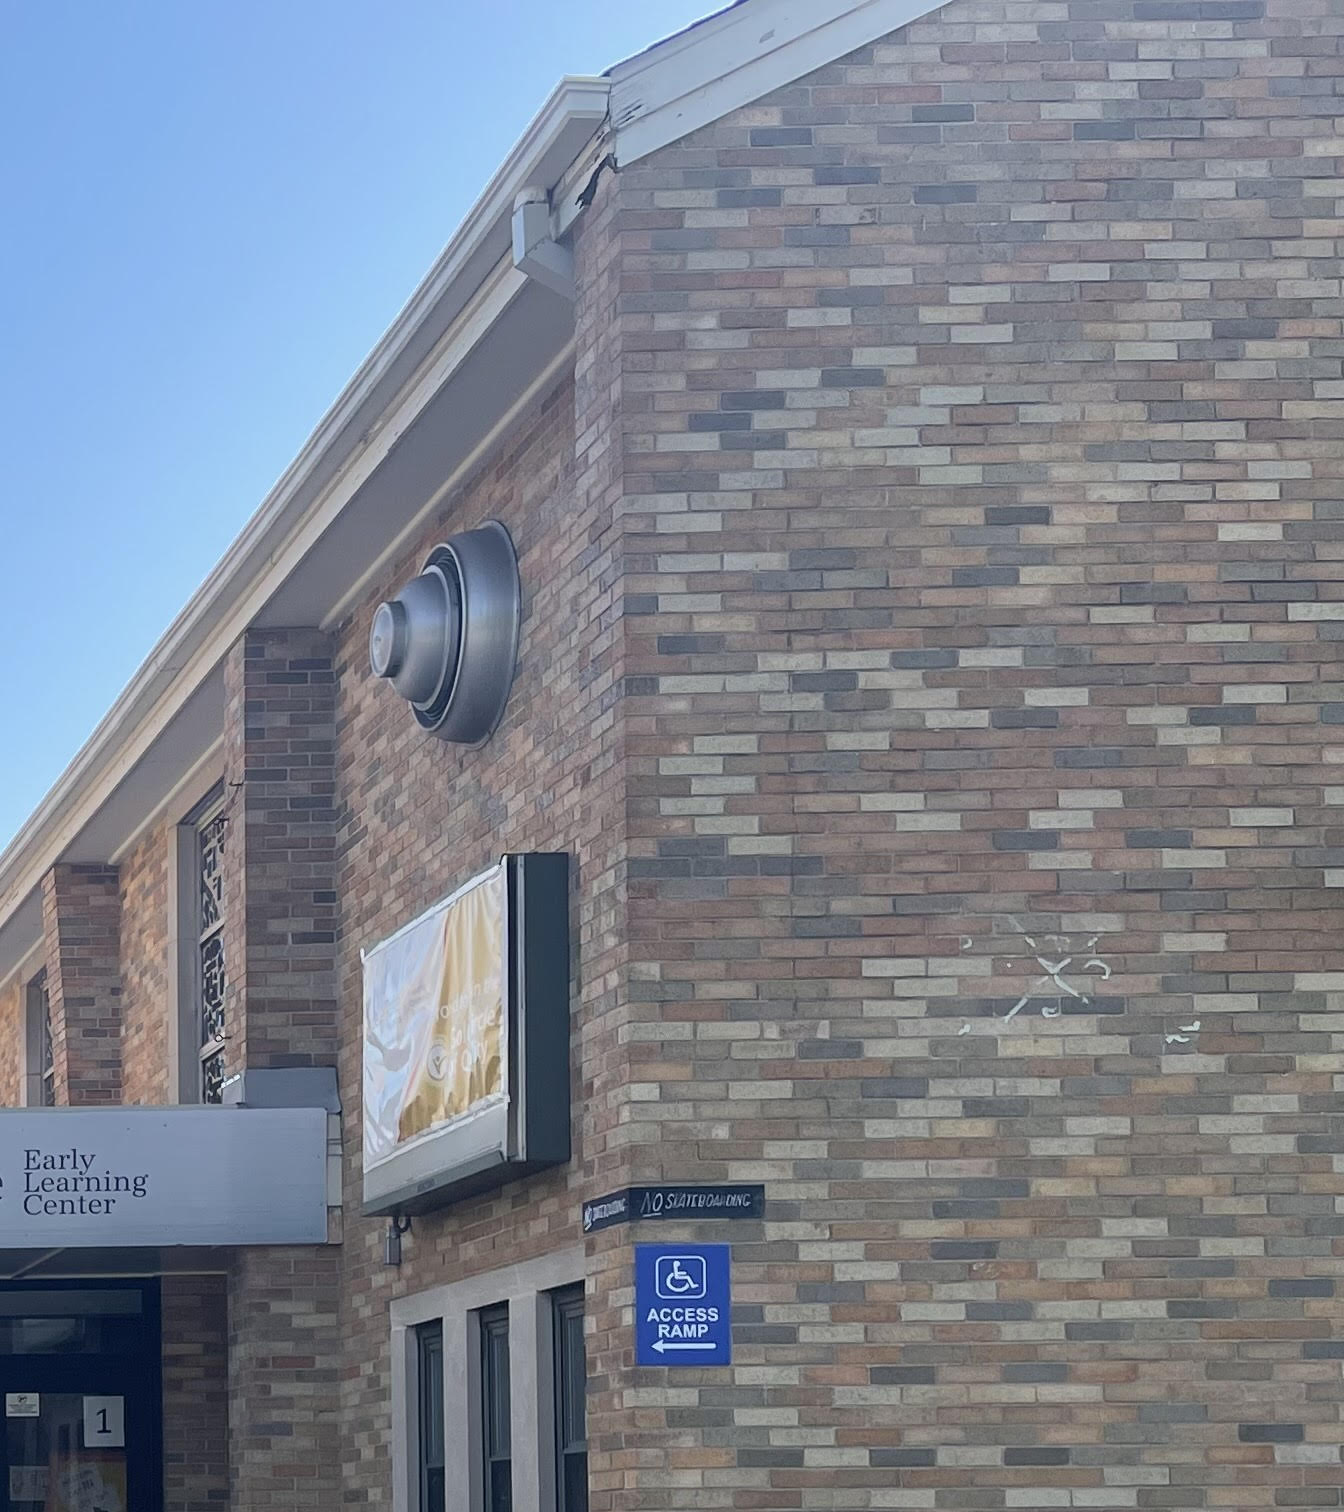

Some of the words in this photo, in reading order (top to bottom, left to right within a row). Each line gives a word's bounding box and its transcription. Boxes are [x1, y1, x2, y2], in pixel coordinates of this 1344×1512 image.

[23, 1149, 97, 1177] Early
[23, 1171, 150, 1199] Learning
[23, 1194, 117, 1217] Center
[640, 1191, 663, 1214] NO
[647, 1307, 719, 1323] ACCESS
[658, 1323, 709, 1339] RAMP
[95, 1408, 112, 1434] 1
